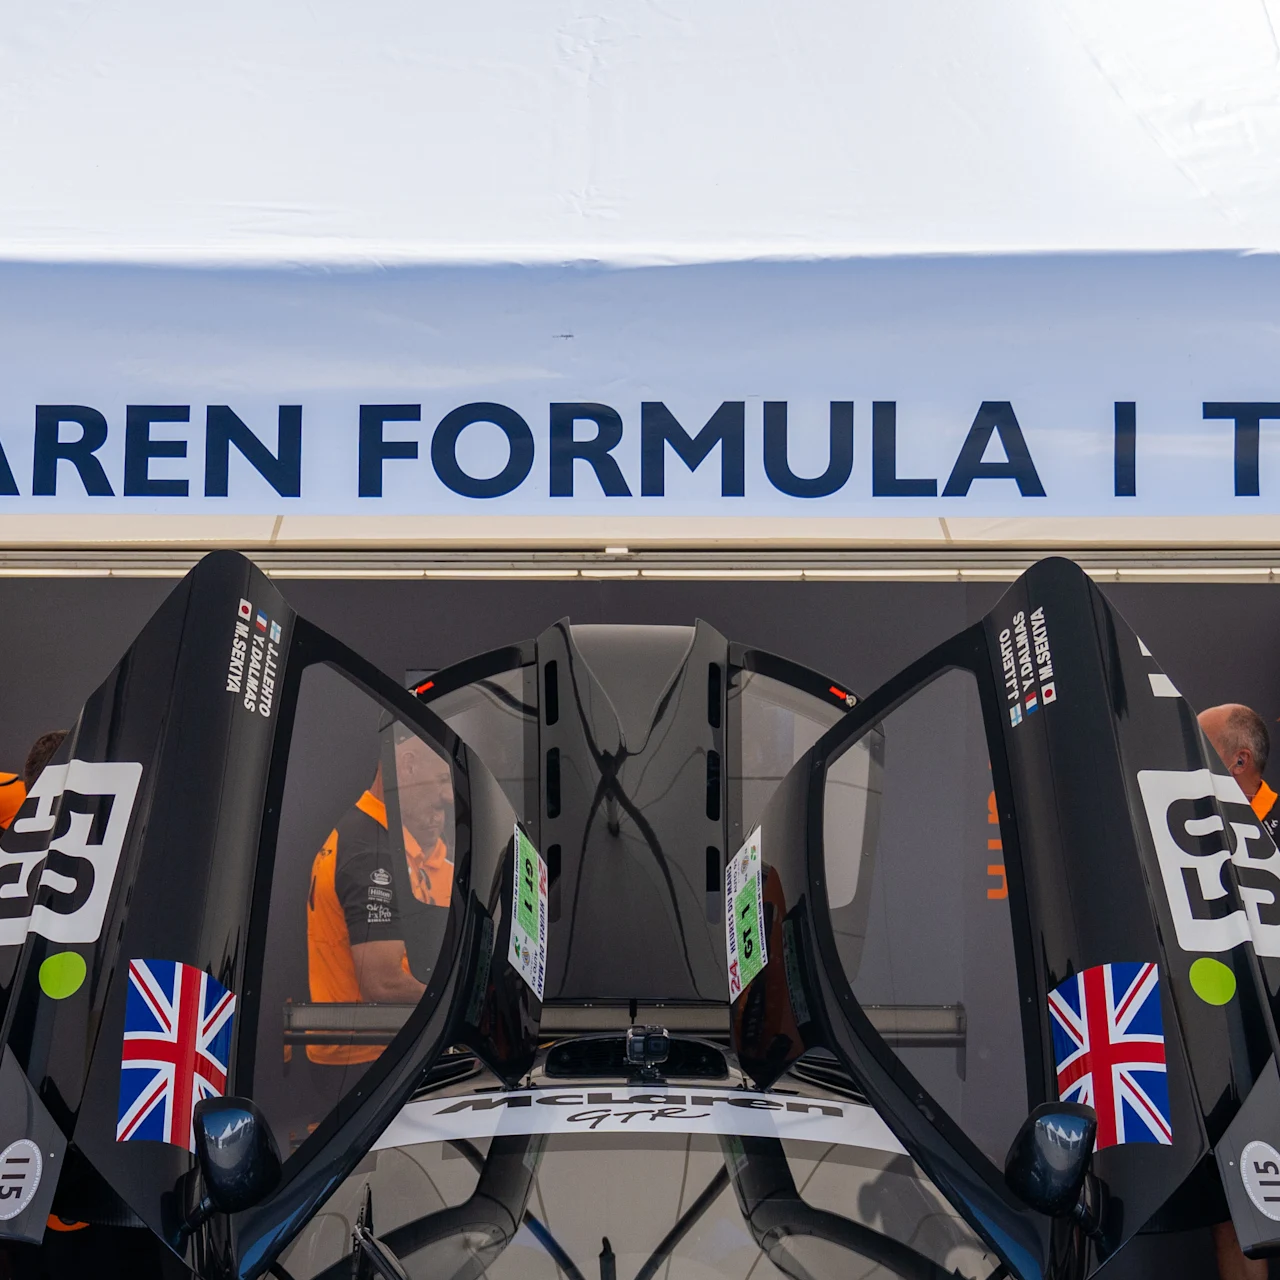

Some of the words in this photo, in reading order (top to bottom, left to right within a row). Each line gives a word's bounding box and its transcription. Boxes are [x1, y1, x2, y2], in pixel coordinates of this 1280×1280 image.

[358, 401, 1047, 499] FORMULA
[226, 621, 249, 693] M.SEKIYA
[1013, 611, 1035, 692] Y.DALMAS
[1030, 606, 1054, 682] M.SEKIYA
[243, 634, 265, 713] Y.DALMAS
[259, 642, 279, 718] J.J.LEHTO
[999, 628, 1020, 700] J.J.LEHTO
[370, 889, 390, 898] Hilton
[525, 858, 533, 893] GT
[538, 857, 547, 898] 24
[524, 900, 533, 913] 1
[727, 897, 733, 912] DU
[741, 903, 751, 920] 1
[728, 914, 736, 954] HEURES
[743, 926, 753, 959] GT
[540, 943, 545, 962] DU
[729, 959, 741, 995] 24
[433, 1091, 844, 1118] McLaren
[567, 1106, 710, 1129] GTR
